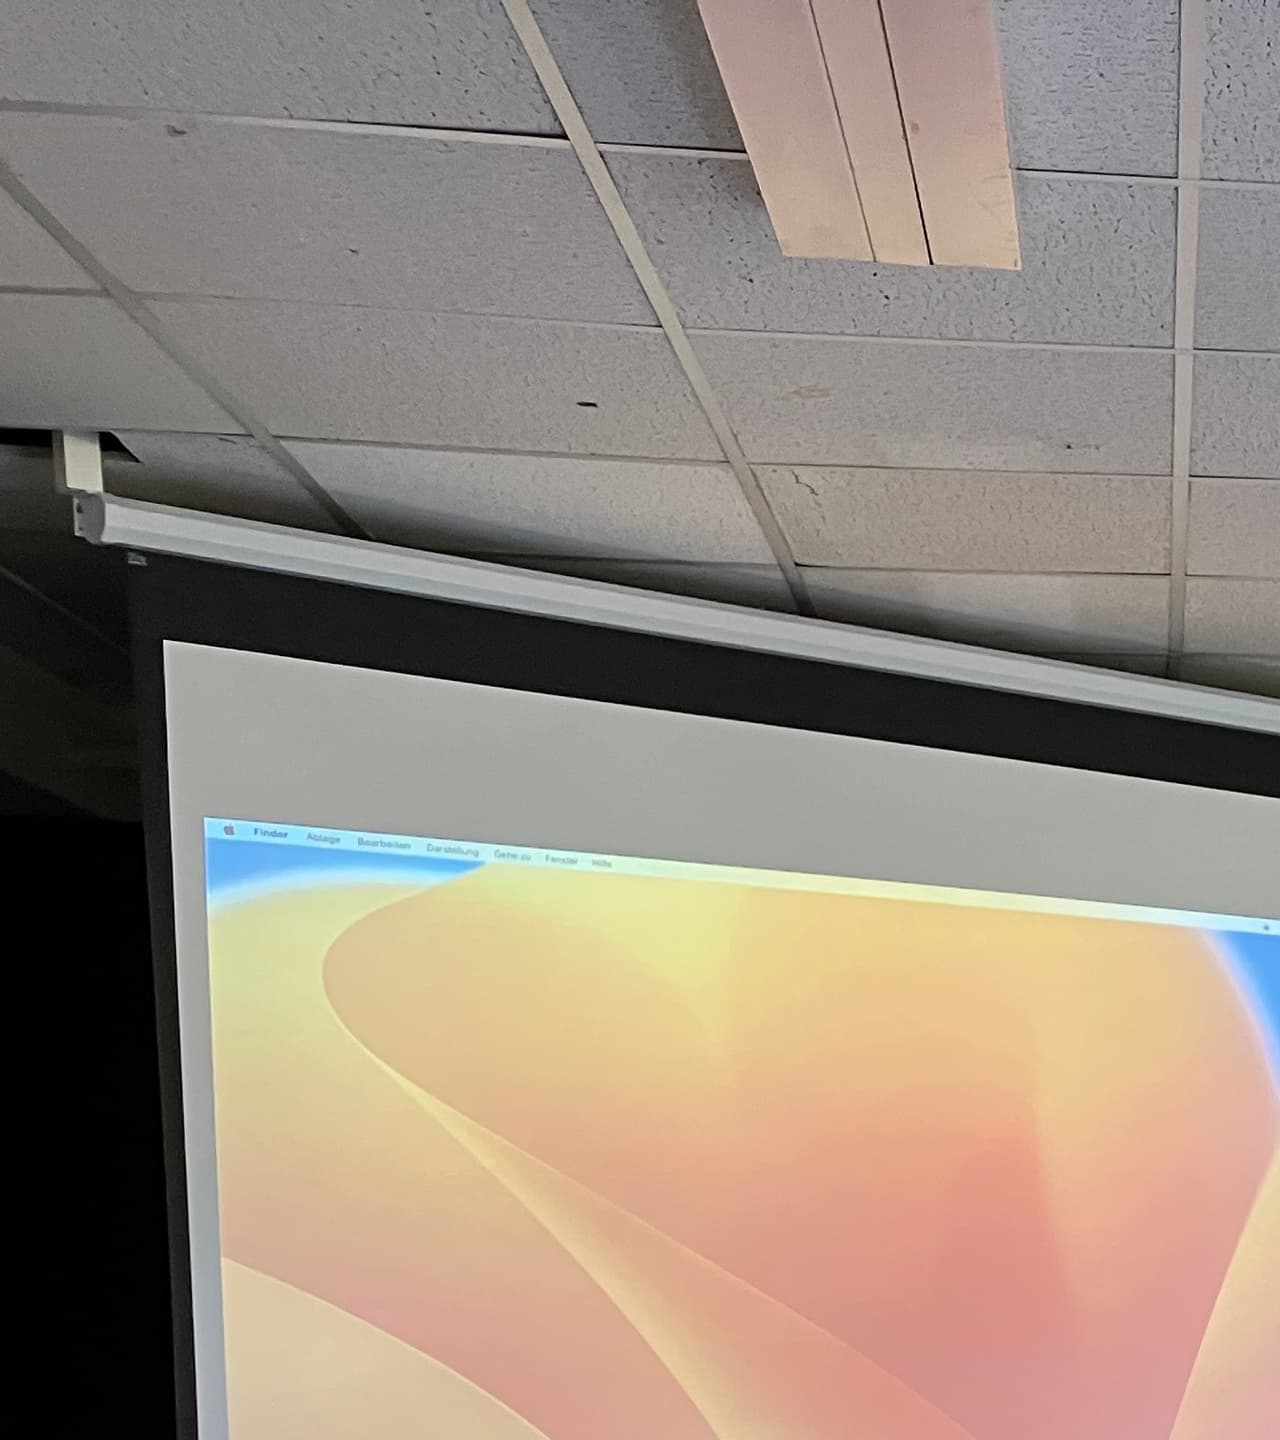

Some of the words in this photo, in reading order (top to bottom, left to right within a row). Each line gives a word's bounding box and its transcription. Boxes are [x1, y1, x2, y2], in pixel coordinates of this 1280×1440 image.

[254, 828, 288, 839] Finder
[307, 832, 341, 845] Ablage
[357, 837, 412, 850] Bearbeiten
[426, 843, 480, 858] Darstellung
